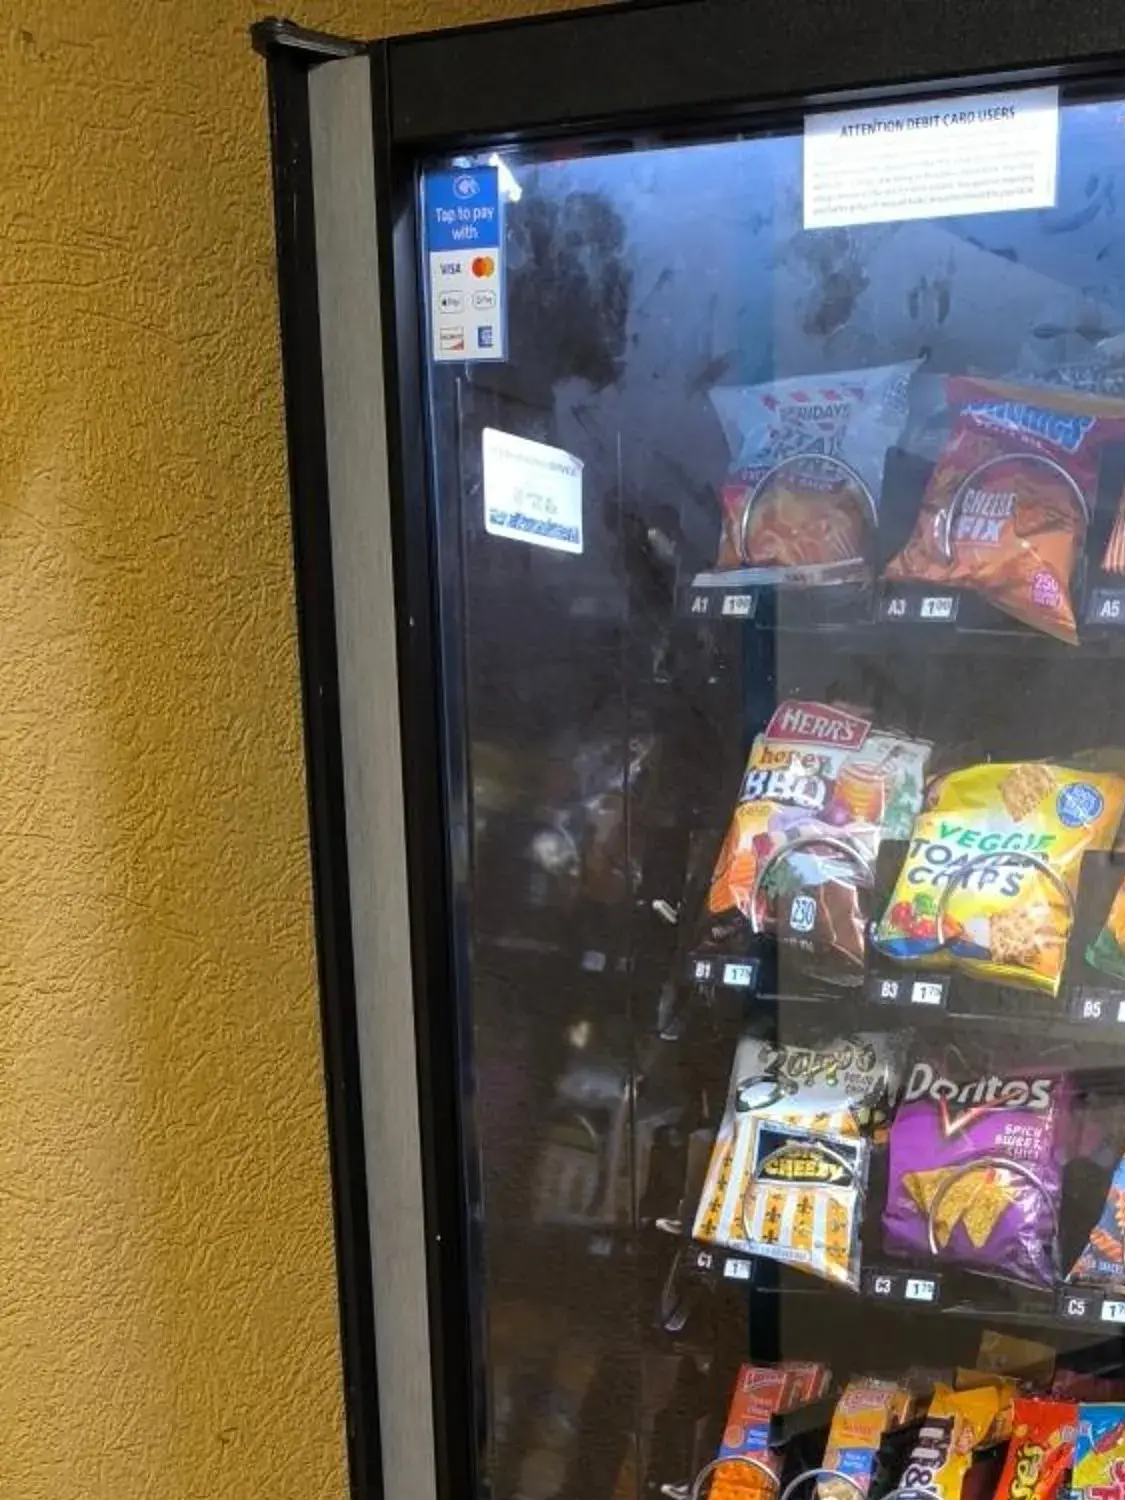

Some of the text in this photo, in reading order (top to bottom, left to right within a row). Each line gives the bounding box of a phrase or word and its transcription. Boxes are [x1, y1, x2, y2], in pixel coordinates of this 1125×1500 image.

[839, 105, 1016, 138] ATTENTION DEBIT CARD USERS
[435, 206, 495, 225] Tap to pay
[451, 226, 479, 241] with
[956, 517, 1000, 541] FIX
[691, 596, 709, 614] A1
[887, 599, 906, 616] A3
[1100, 600, 1120, 617] A5
[938, 820, 1056, 853] VEGGIE
[905, 1062, 1053, 1109] Doritos
[875, 1278, 891, 1294] C3
[1067, 1299, 1086, 1316] C5
